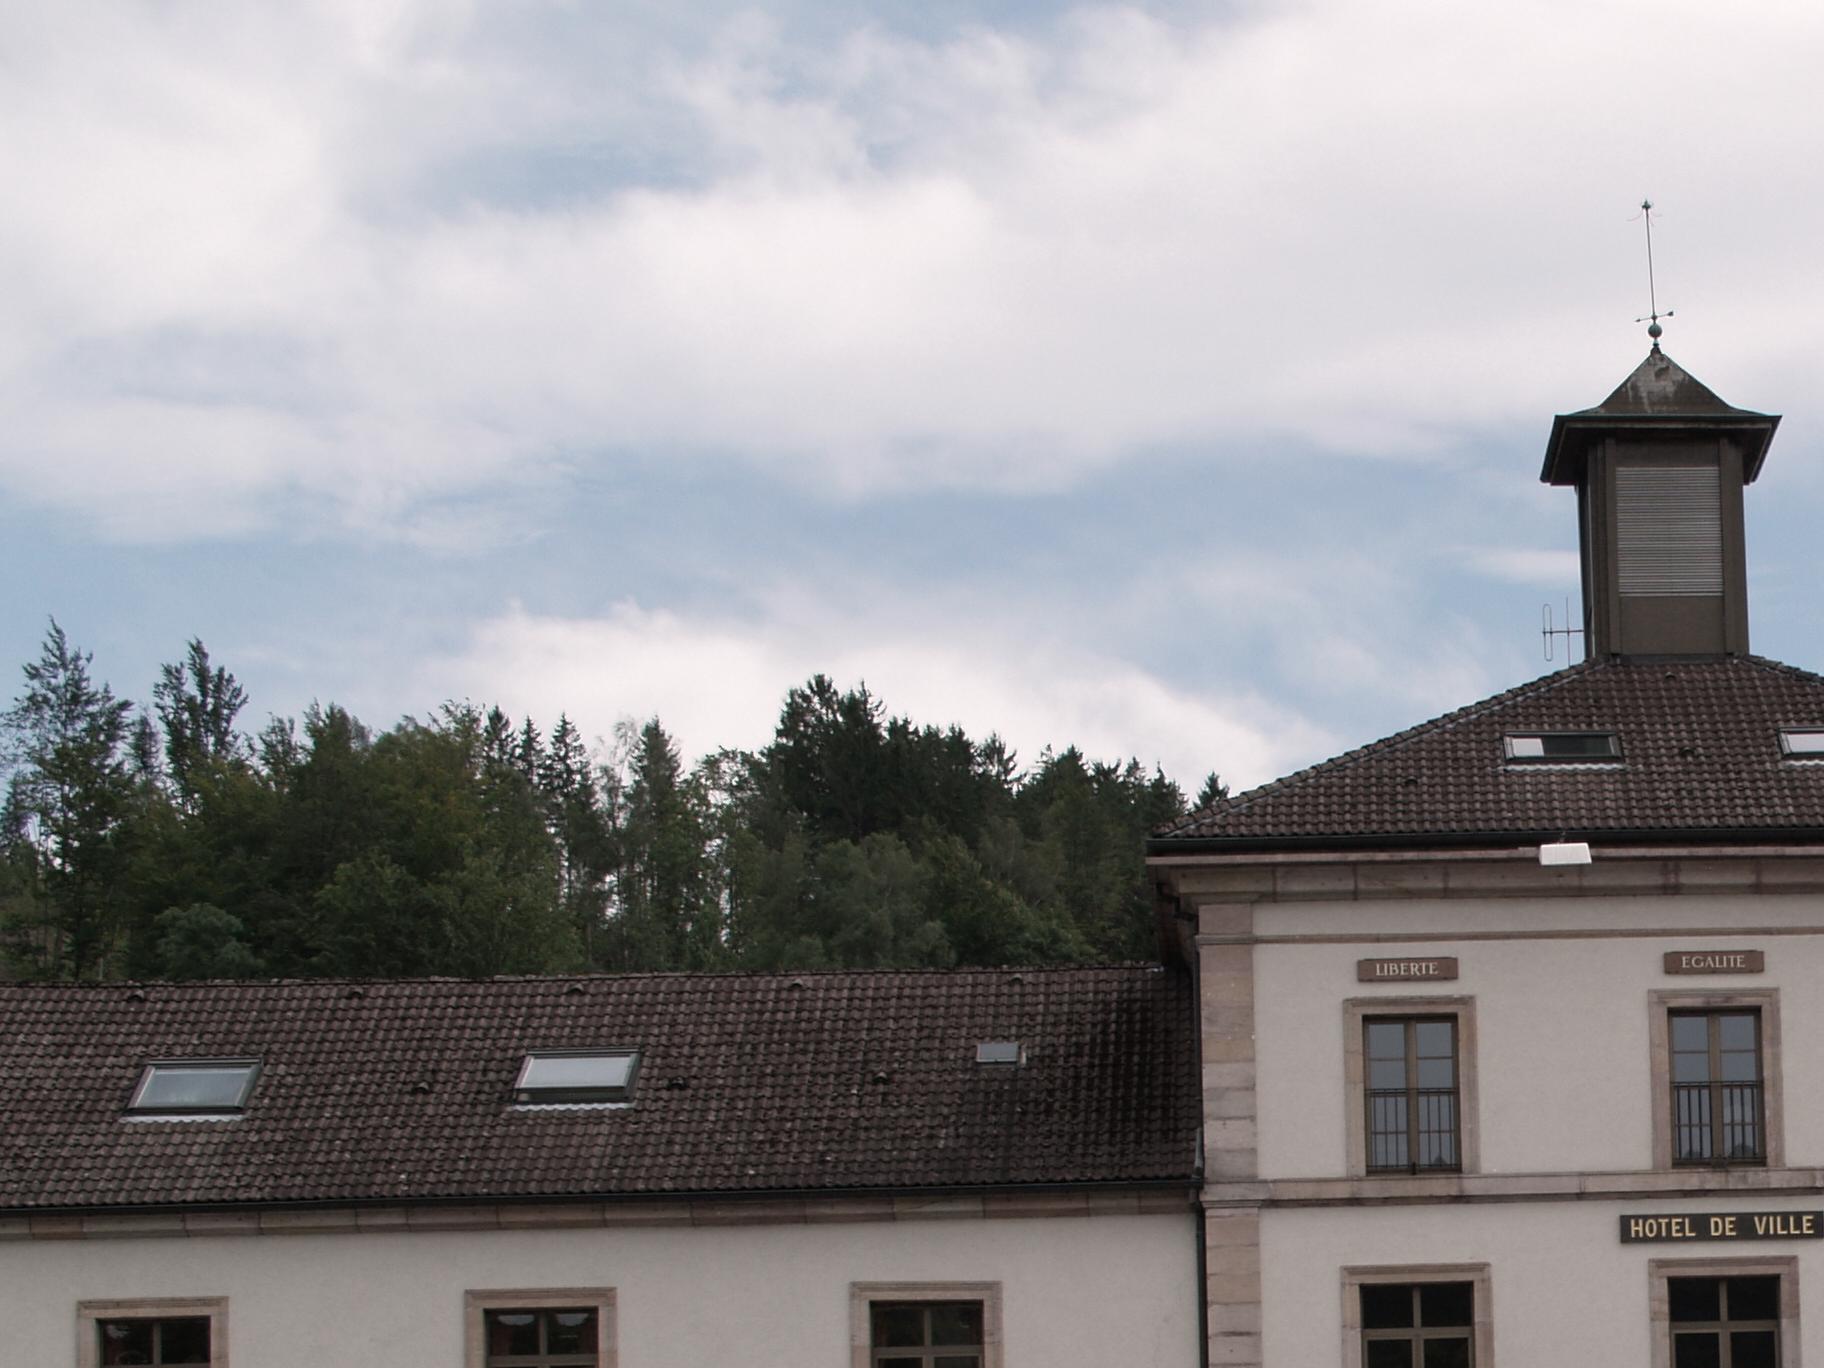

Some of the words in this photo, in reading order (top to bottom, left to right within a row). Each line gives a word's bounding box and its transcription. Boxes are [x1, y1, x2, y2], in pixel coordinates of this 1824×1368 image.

[1681, 955, 1746, 968] EGALITE
[1375, 962, 1438, 976] LIBERTE
[1630, 1217, 1696, 1238] HOTEL
[1709, 1216, 1736, 1236] DE
[1754, 1215, 1814, 1235] VILLE
